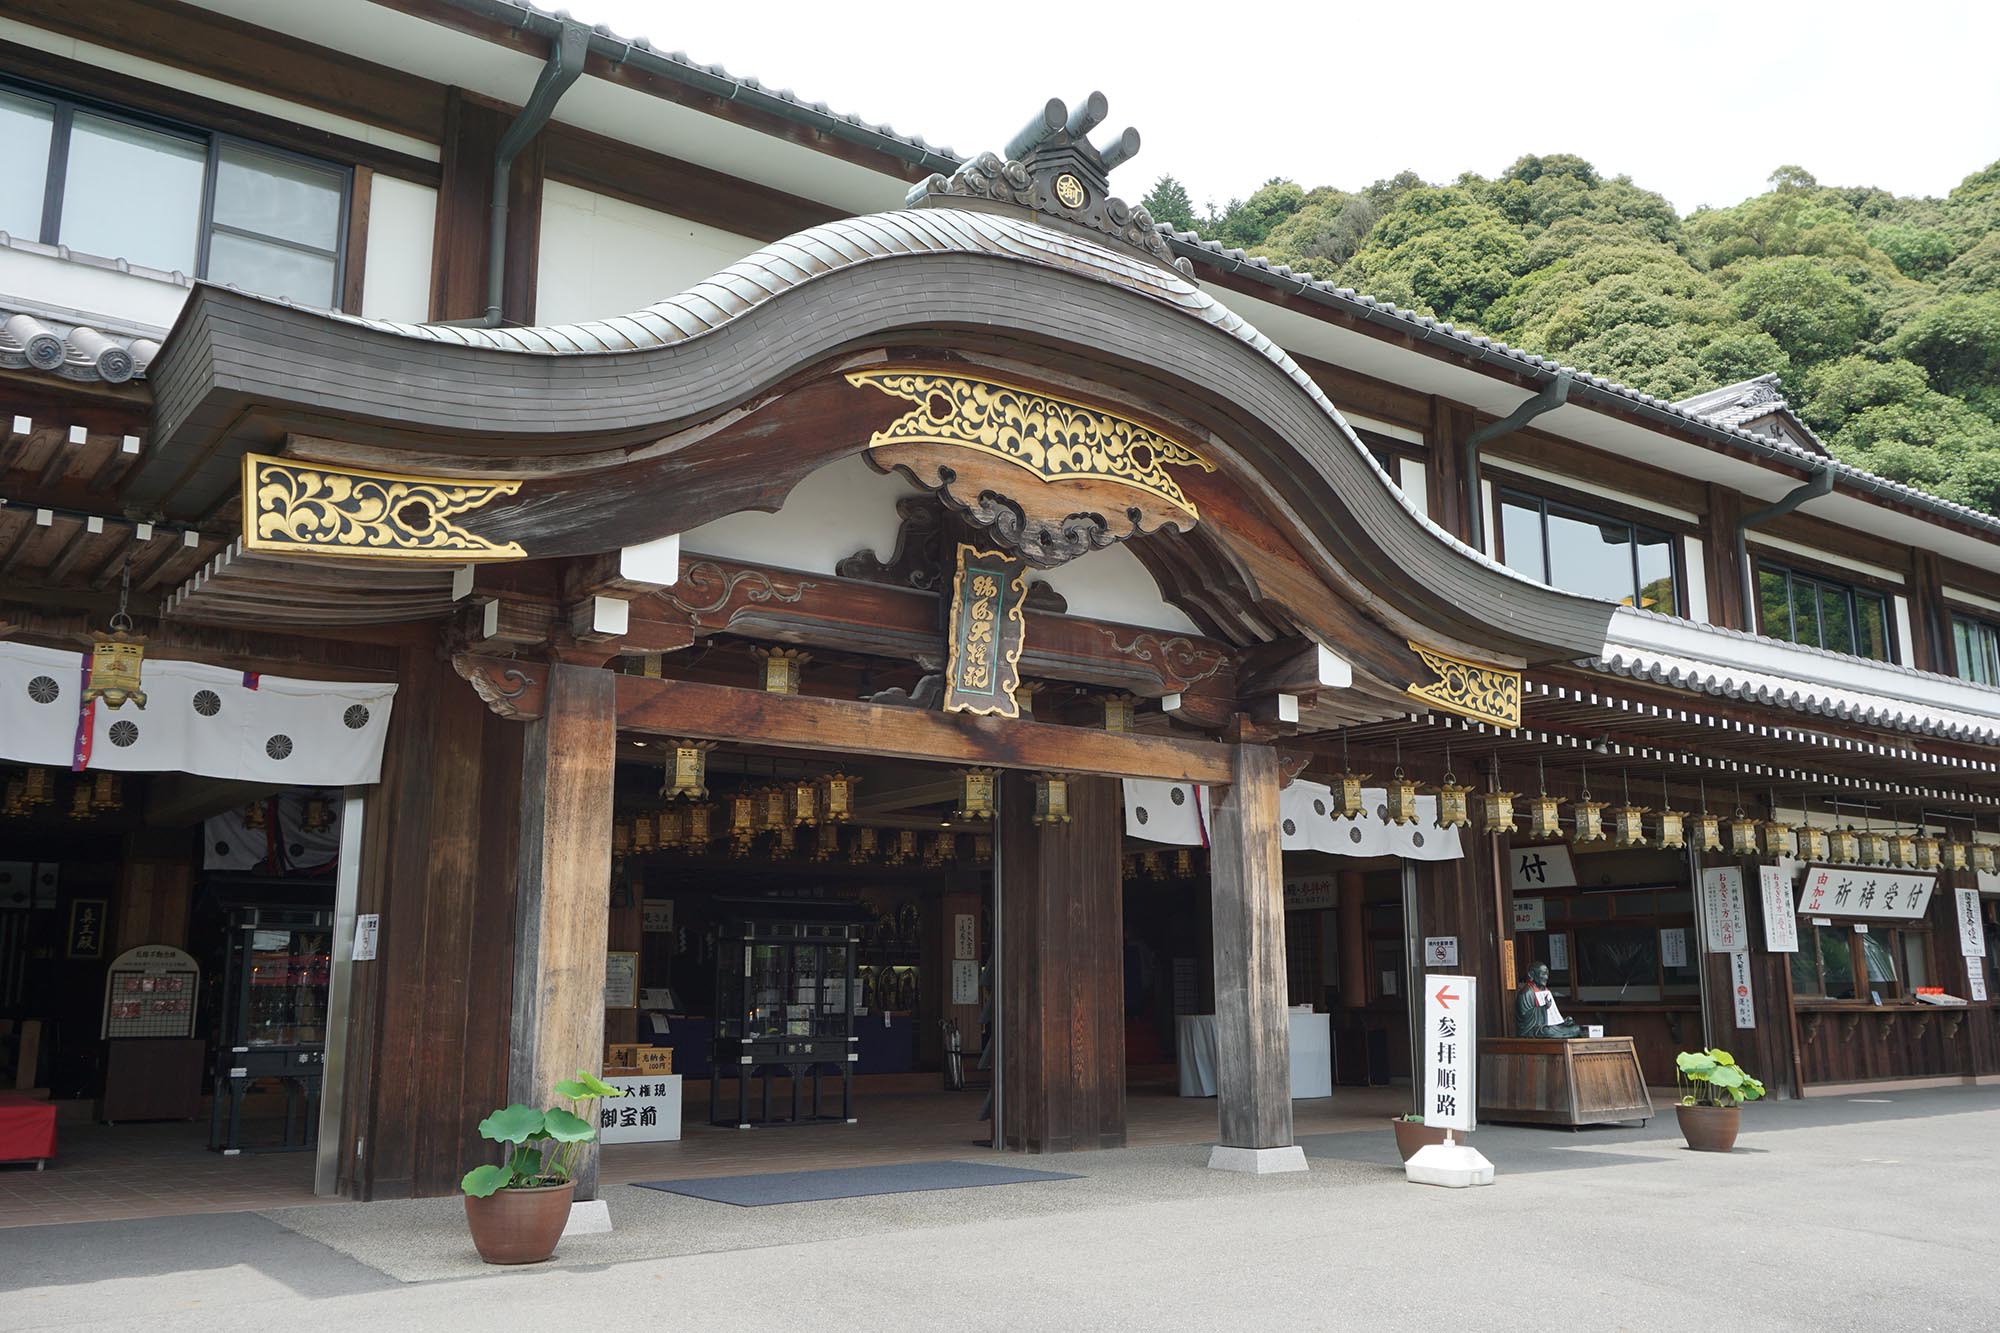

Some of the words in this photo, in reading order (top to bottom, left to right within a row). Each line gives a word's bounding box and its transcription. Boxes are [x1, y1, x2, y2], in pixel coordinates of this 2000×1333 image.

[1519, 853, 1548, 883] 付
[1808, 872, 1829, 910] 由加山
[1437, 1016, 1456, 1116] 参拝順路
[601, 1105, 657, 1128] 御宝前
